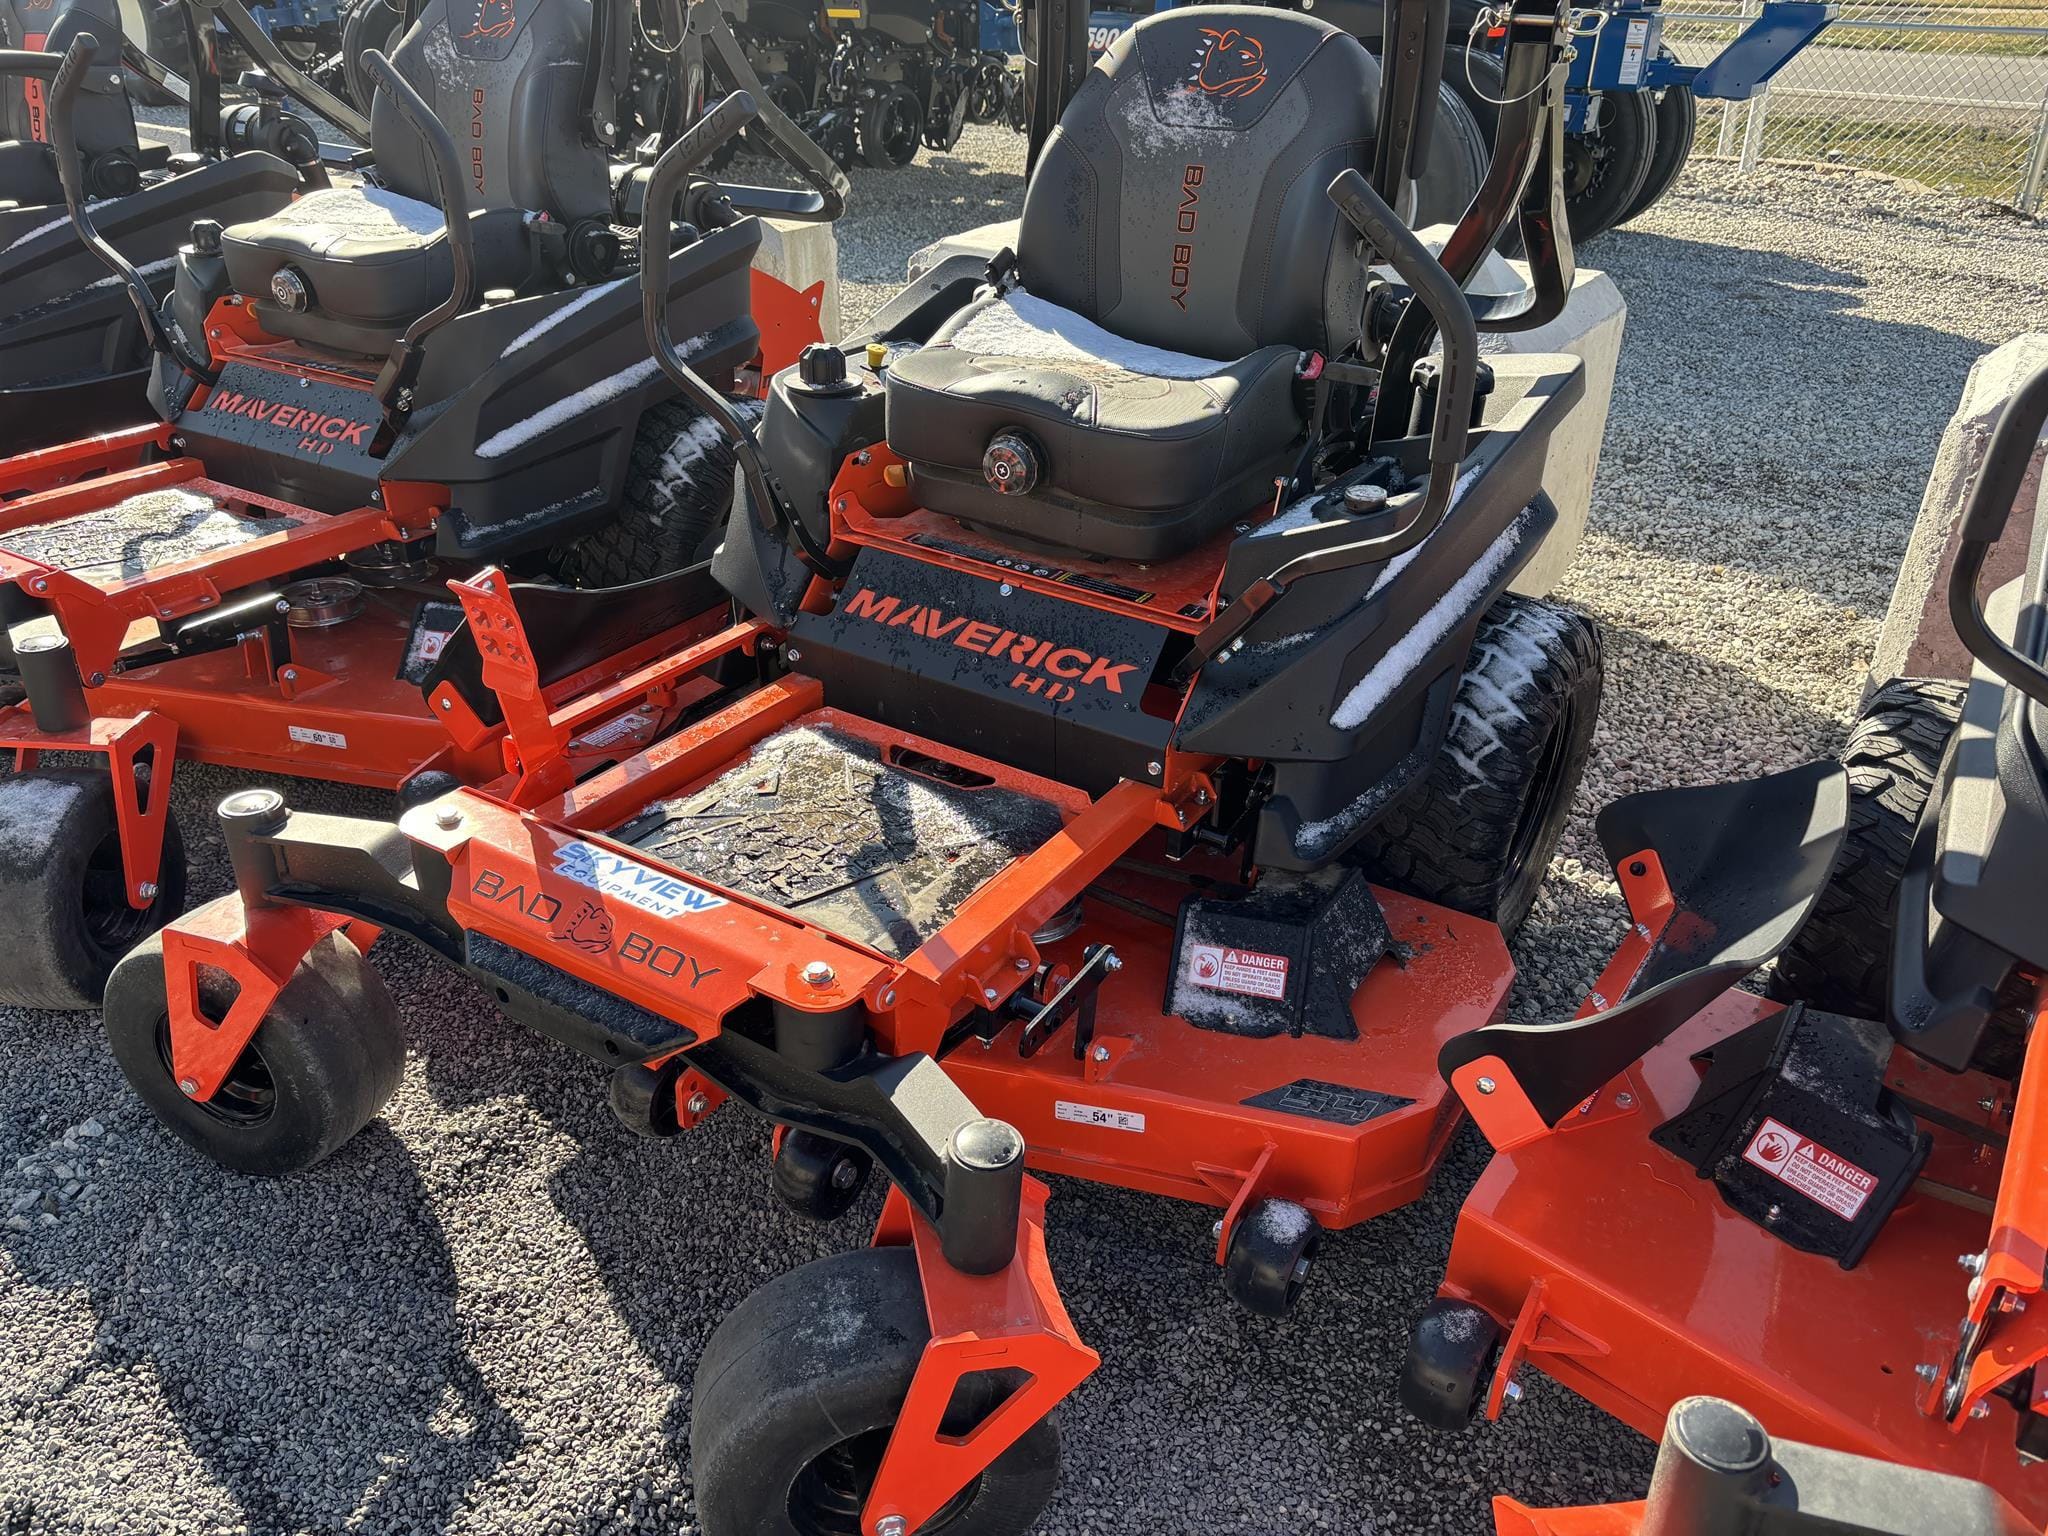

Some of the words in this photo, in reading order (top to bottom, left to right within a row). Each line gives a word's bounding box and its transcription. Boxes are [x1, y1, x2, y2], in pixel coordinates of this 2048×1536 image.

[471, 87, 485, 139] BAD
[471, 146, 485, 196] BOY
[1176, 163, 1206, 234] BAD
[1170, 243, 1193, 313] BOY
[211, 390, 372, 446] MAVERICK
[298, 437, 335, 456] HD
[843, 588, 1139, 694] MAVERICK
[1010, 672, 1076, 702] HD
[560, 843, 722, 910] SKYVIEW
[560, 864, 679, 916] EQUIPMENT
[472, 869, 563, 924] BAD
[618, 930, 722, 989] BOY
[1241, 953, 1284, 969] DANGER
[1278, 1085, 1380, 1121] 54
[1786, 1174, 1811, 1192] CATCHER
[1786, 1166, 1808, 1182] UNLESS
[1807, 1178, 1826, 1193] GUARD
[1834, 1195, 1855, 1210] GRASS
[1793, 1154, 1808, 1165] KEEP
[1807, 1162, 1827, 1177] HANDS
[1831, 1176, 1845, 1187] FEET
[1799, 1166, 1811, 1176] NOT
[1810, 1173, 1836, 1190] OPERATE
[1835, 1187, 1858, 1203] MOWER
[1817, 1152, 1872, 1189] DANGER
